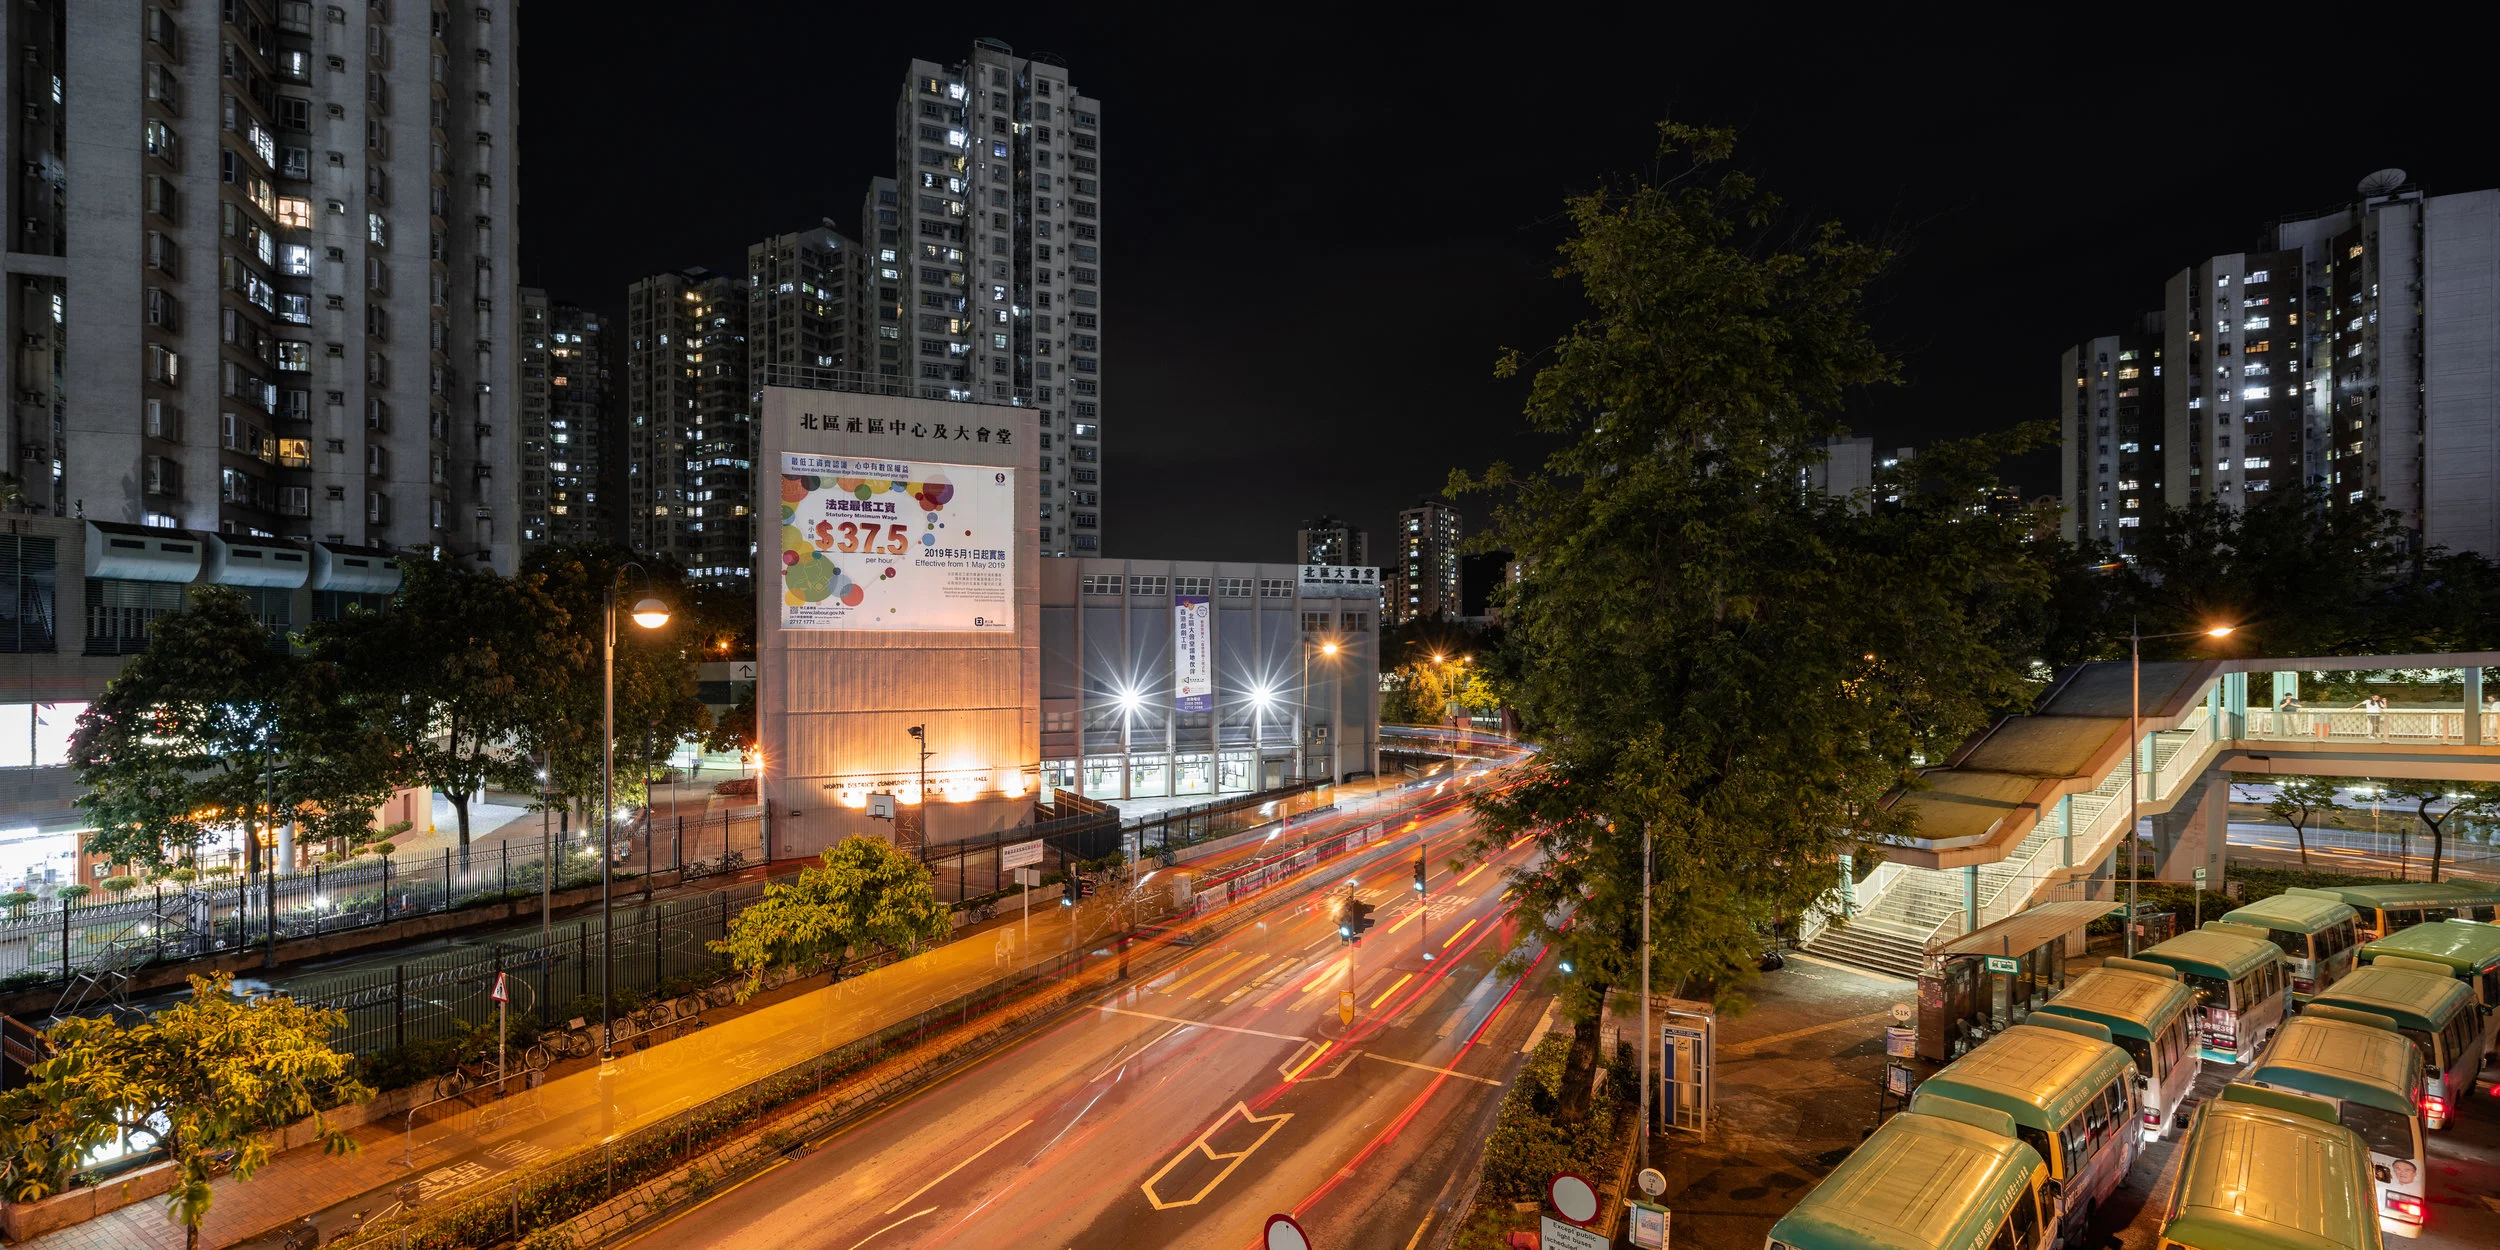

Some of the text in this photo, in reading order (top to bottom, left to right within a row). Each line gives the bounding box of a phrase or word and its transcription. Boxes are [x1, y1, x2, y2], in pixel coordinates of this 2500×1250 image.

[800, 413, 1012, 445] 北區社區中心及大會堂
[854, 461, 909, 474] 心中有數保權益
[826, 499, 896, 513] 法定最低工資
[825, 511, 853, 519] Statutory
[815, 519, 908, 555] $37.5
[915, 559, 946, 568] Effective
[947, 560, 964, 568] from
[971, 562, 986, 570] May
[1304, 566, 1375, 579] 北區大會堂
[847, 781, 875, 789] DISTRICT
[877, 779, 911, 787] COMMUNITY
[1553, 1221, 1597, 1242] Except public
[1556, 1231, 1592, 1249] light buses
